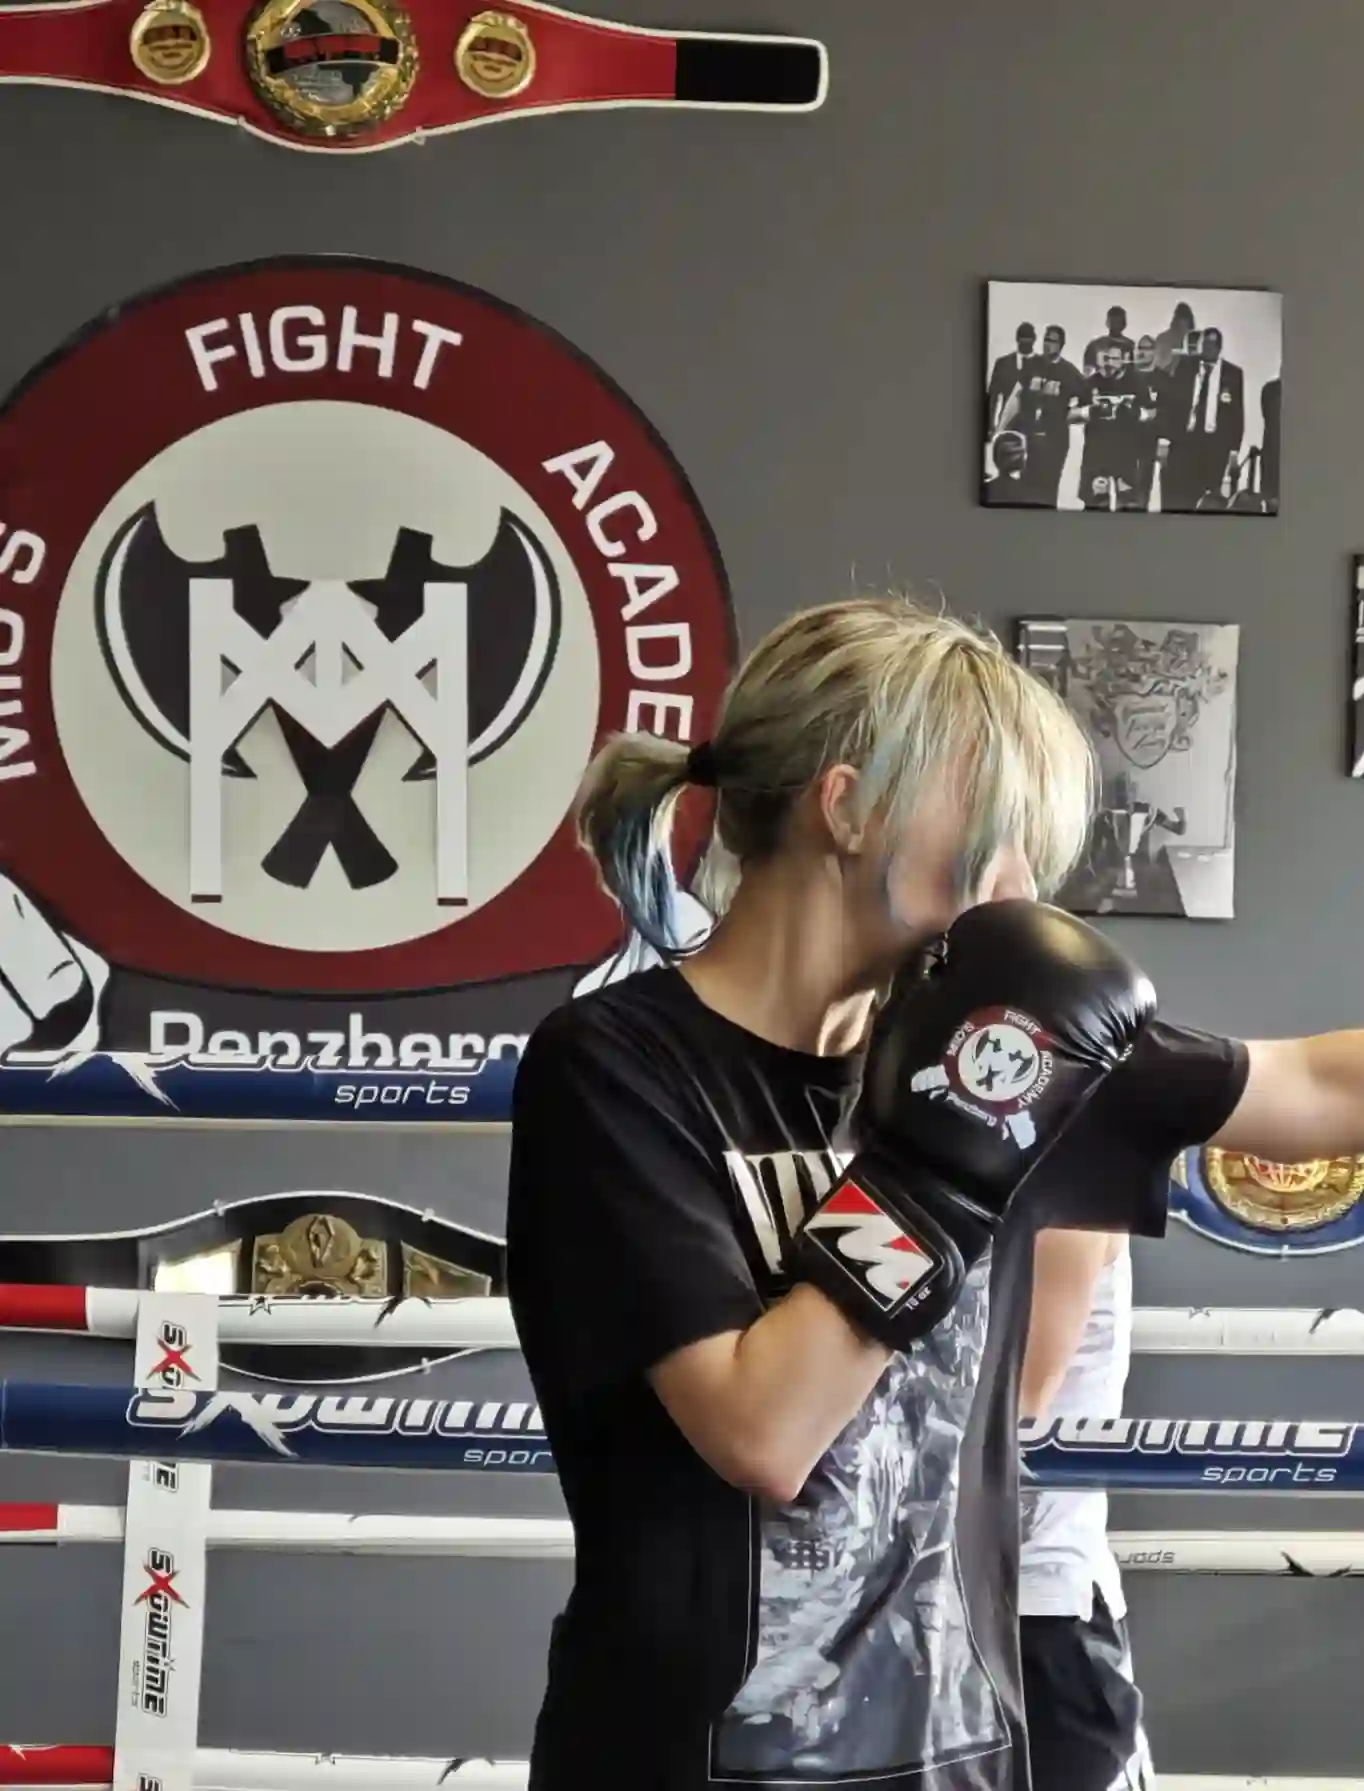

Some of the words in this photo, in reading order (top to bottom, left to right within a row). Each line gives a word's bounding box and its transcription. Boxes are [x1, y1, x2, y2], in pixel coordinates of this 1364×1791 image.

[185, 304, 463, 391] FIGHT
[541, 440, 694, 740] ACADE
[334, 1078, 471, 1110] sports
[463, 1448, 553, 1468] spor
[1200, 1461, 1339, 1485] sports
